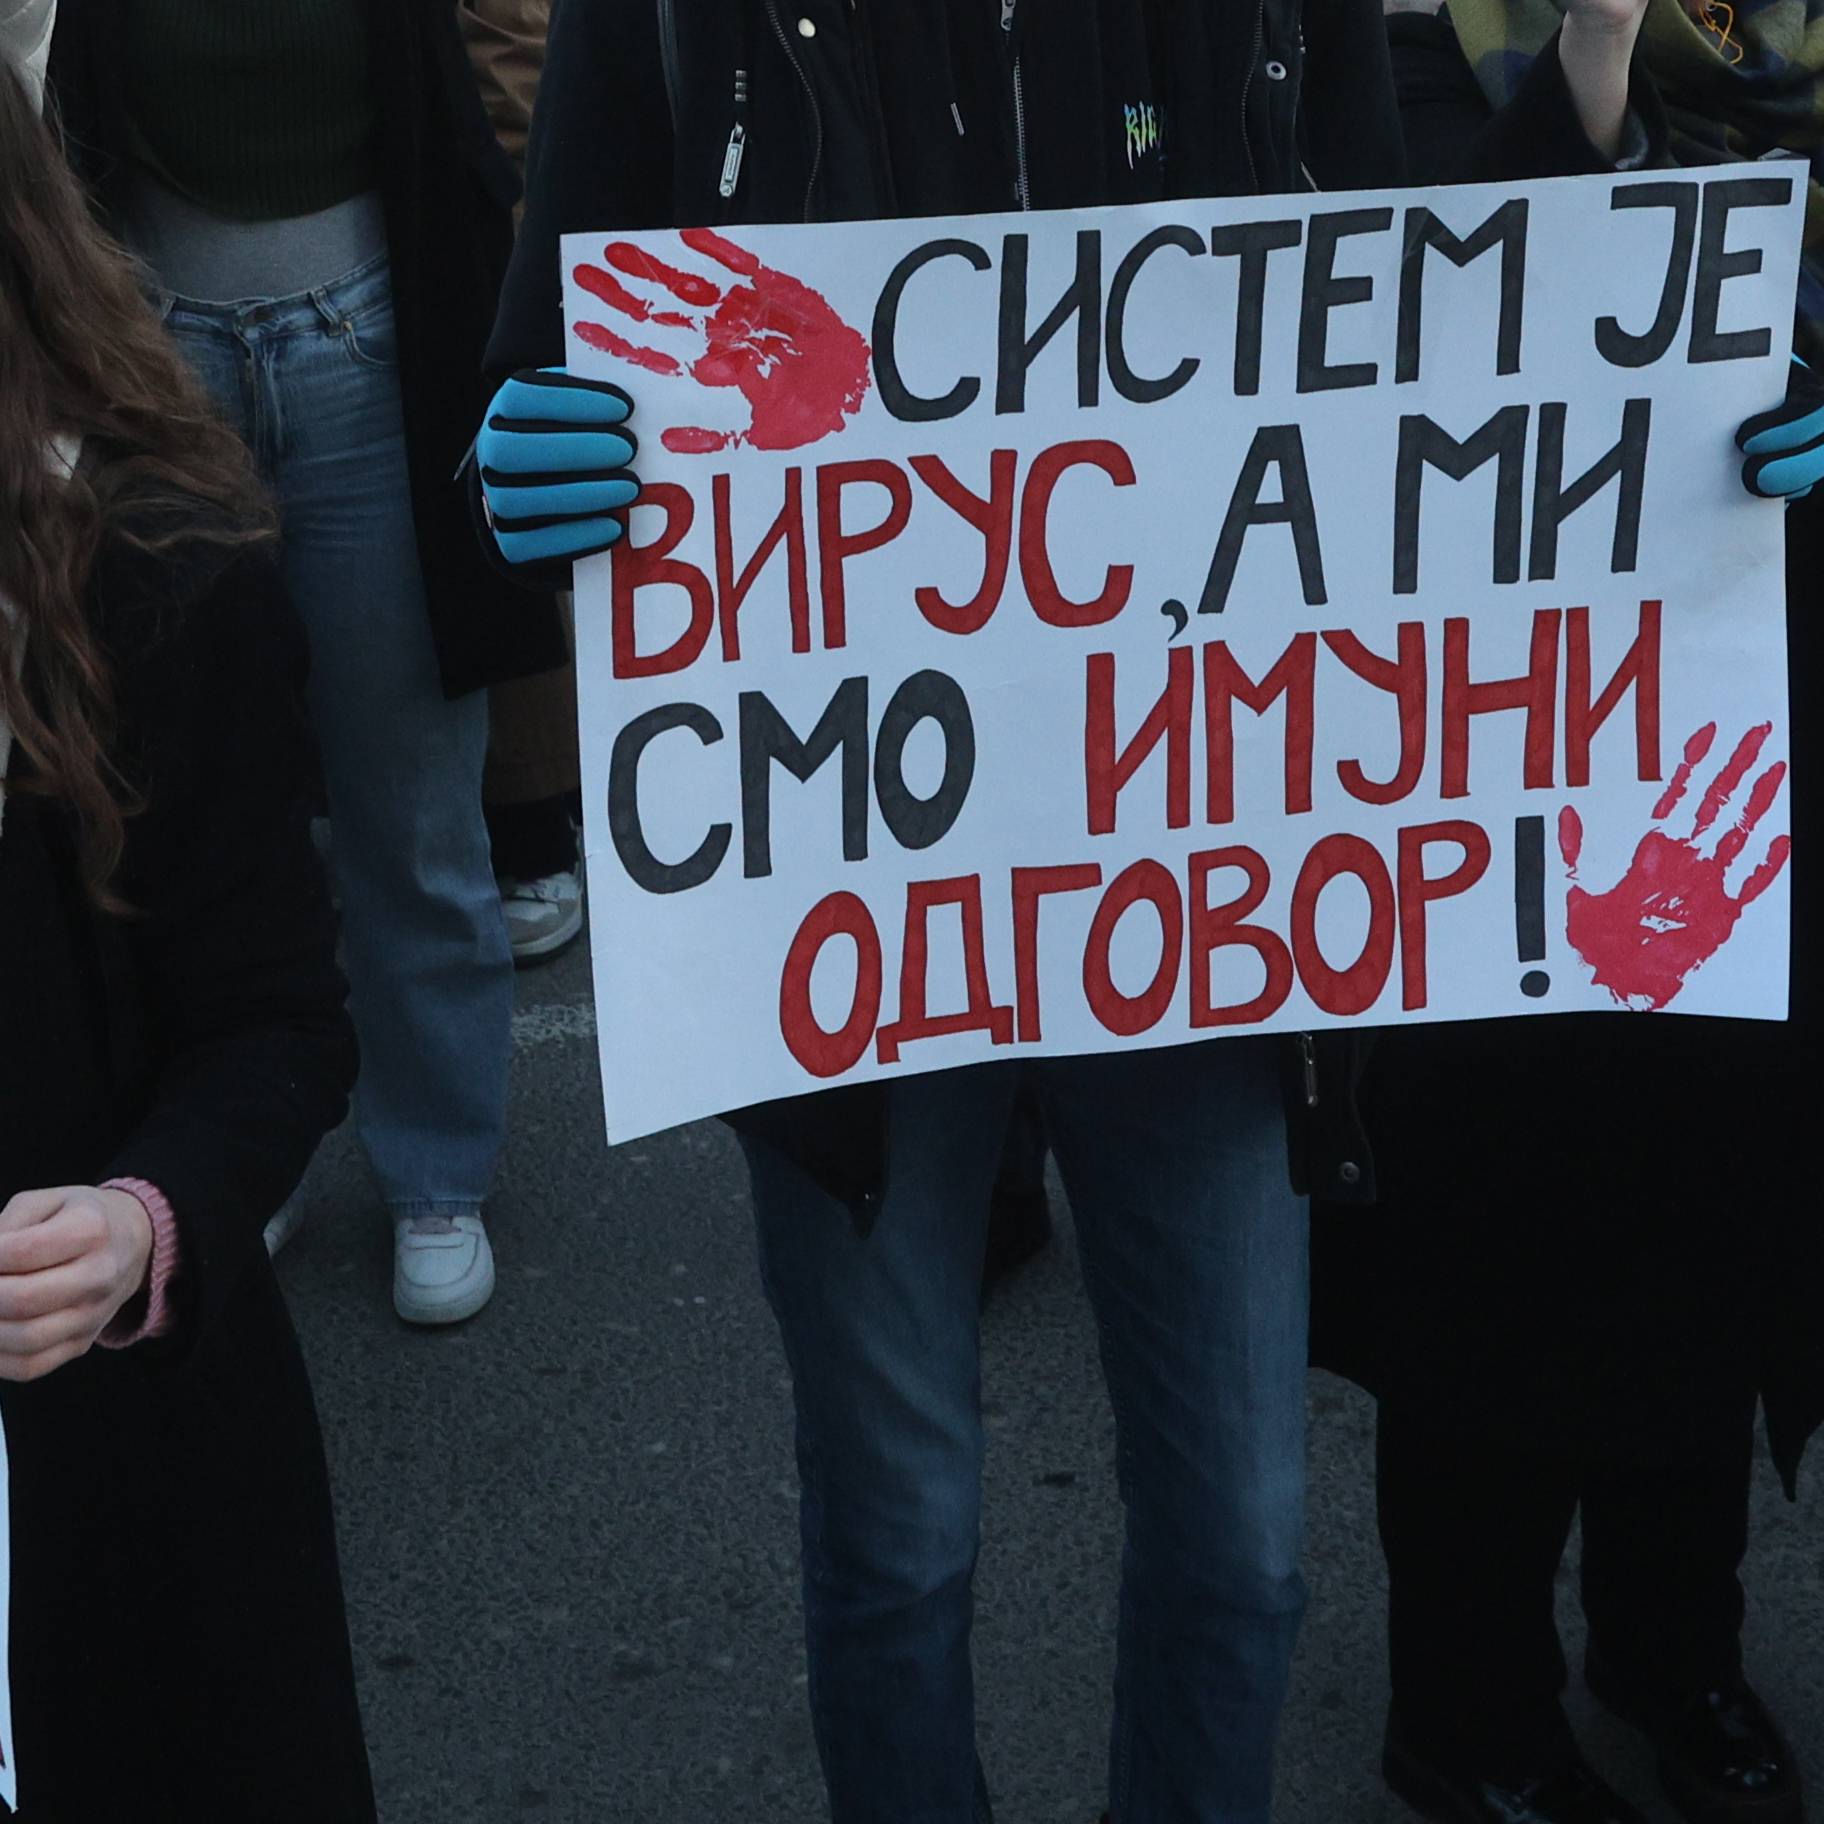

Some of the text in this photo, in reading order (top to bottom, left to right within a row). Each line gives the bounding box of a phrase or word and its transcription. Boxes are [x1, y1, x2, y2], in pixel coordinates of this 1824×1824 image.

[873, 176, 1793, 423] СИСТЕМ ЈЕ
[1197, 422, 1328, 614] А
[1391, 397, 1653, 595] МИ
[607, 599, 1663, 894] СМО ИМУНИ
[778, 812, 1553, 1079] ОДГОВОР!
